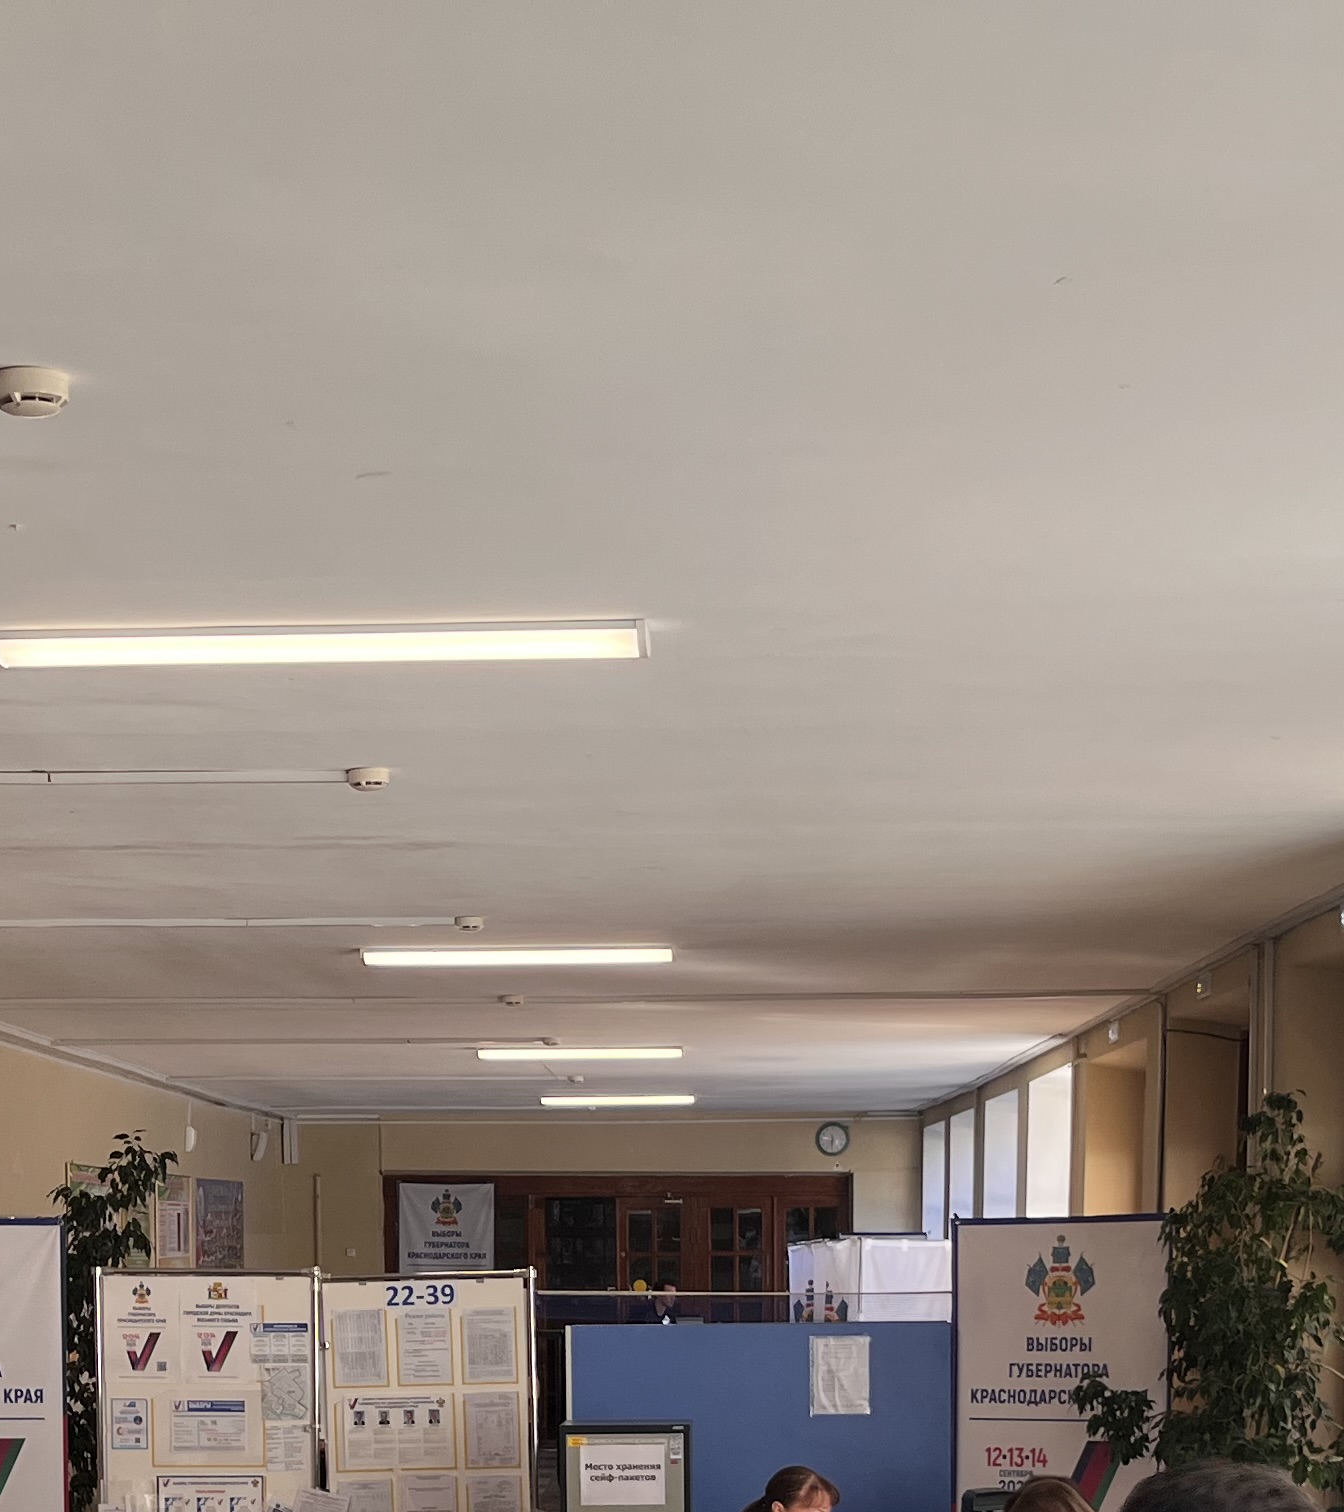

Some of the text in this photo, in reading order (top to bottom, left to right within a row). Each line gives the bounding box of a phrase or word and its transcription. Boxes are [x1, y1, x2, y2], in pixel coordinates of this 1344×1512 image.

[408, 1252, 468, 1260] КРАСНОДАРСКОГО
[385, 1284, 455, 1306] 22-39
[1026, 1337, 1092, 1352] ВЫБОРЫ
[1009, 1363, 1109, 1379] ГУБЕРНАТОРА
[4, 1388, 44, 1404] КРАЯ
[985, 1447, 1048, 1467] 12·13·14
[585, 1463, 661, 1472] Место хранения
[999, 1470, 1033, 1478] СЕНТЯБРЯ
[590, 1473, 656, 1483] сейф-пакетов
